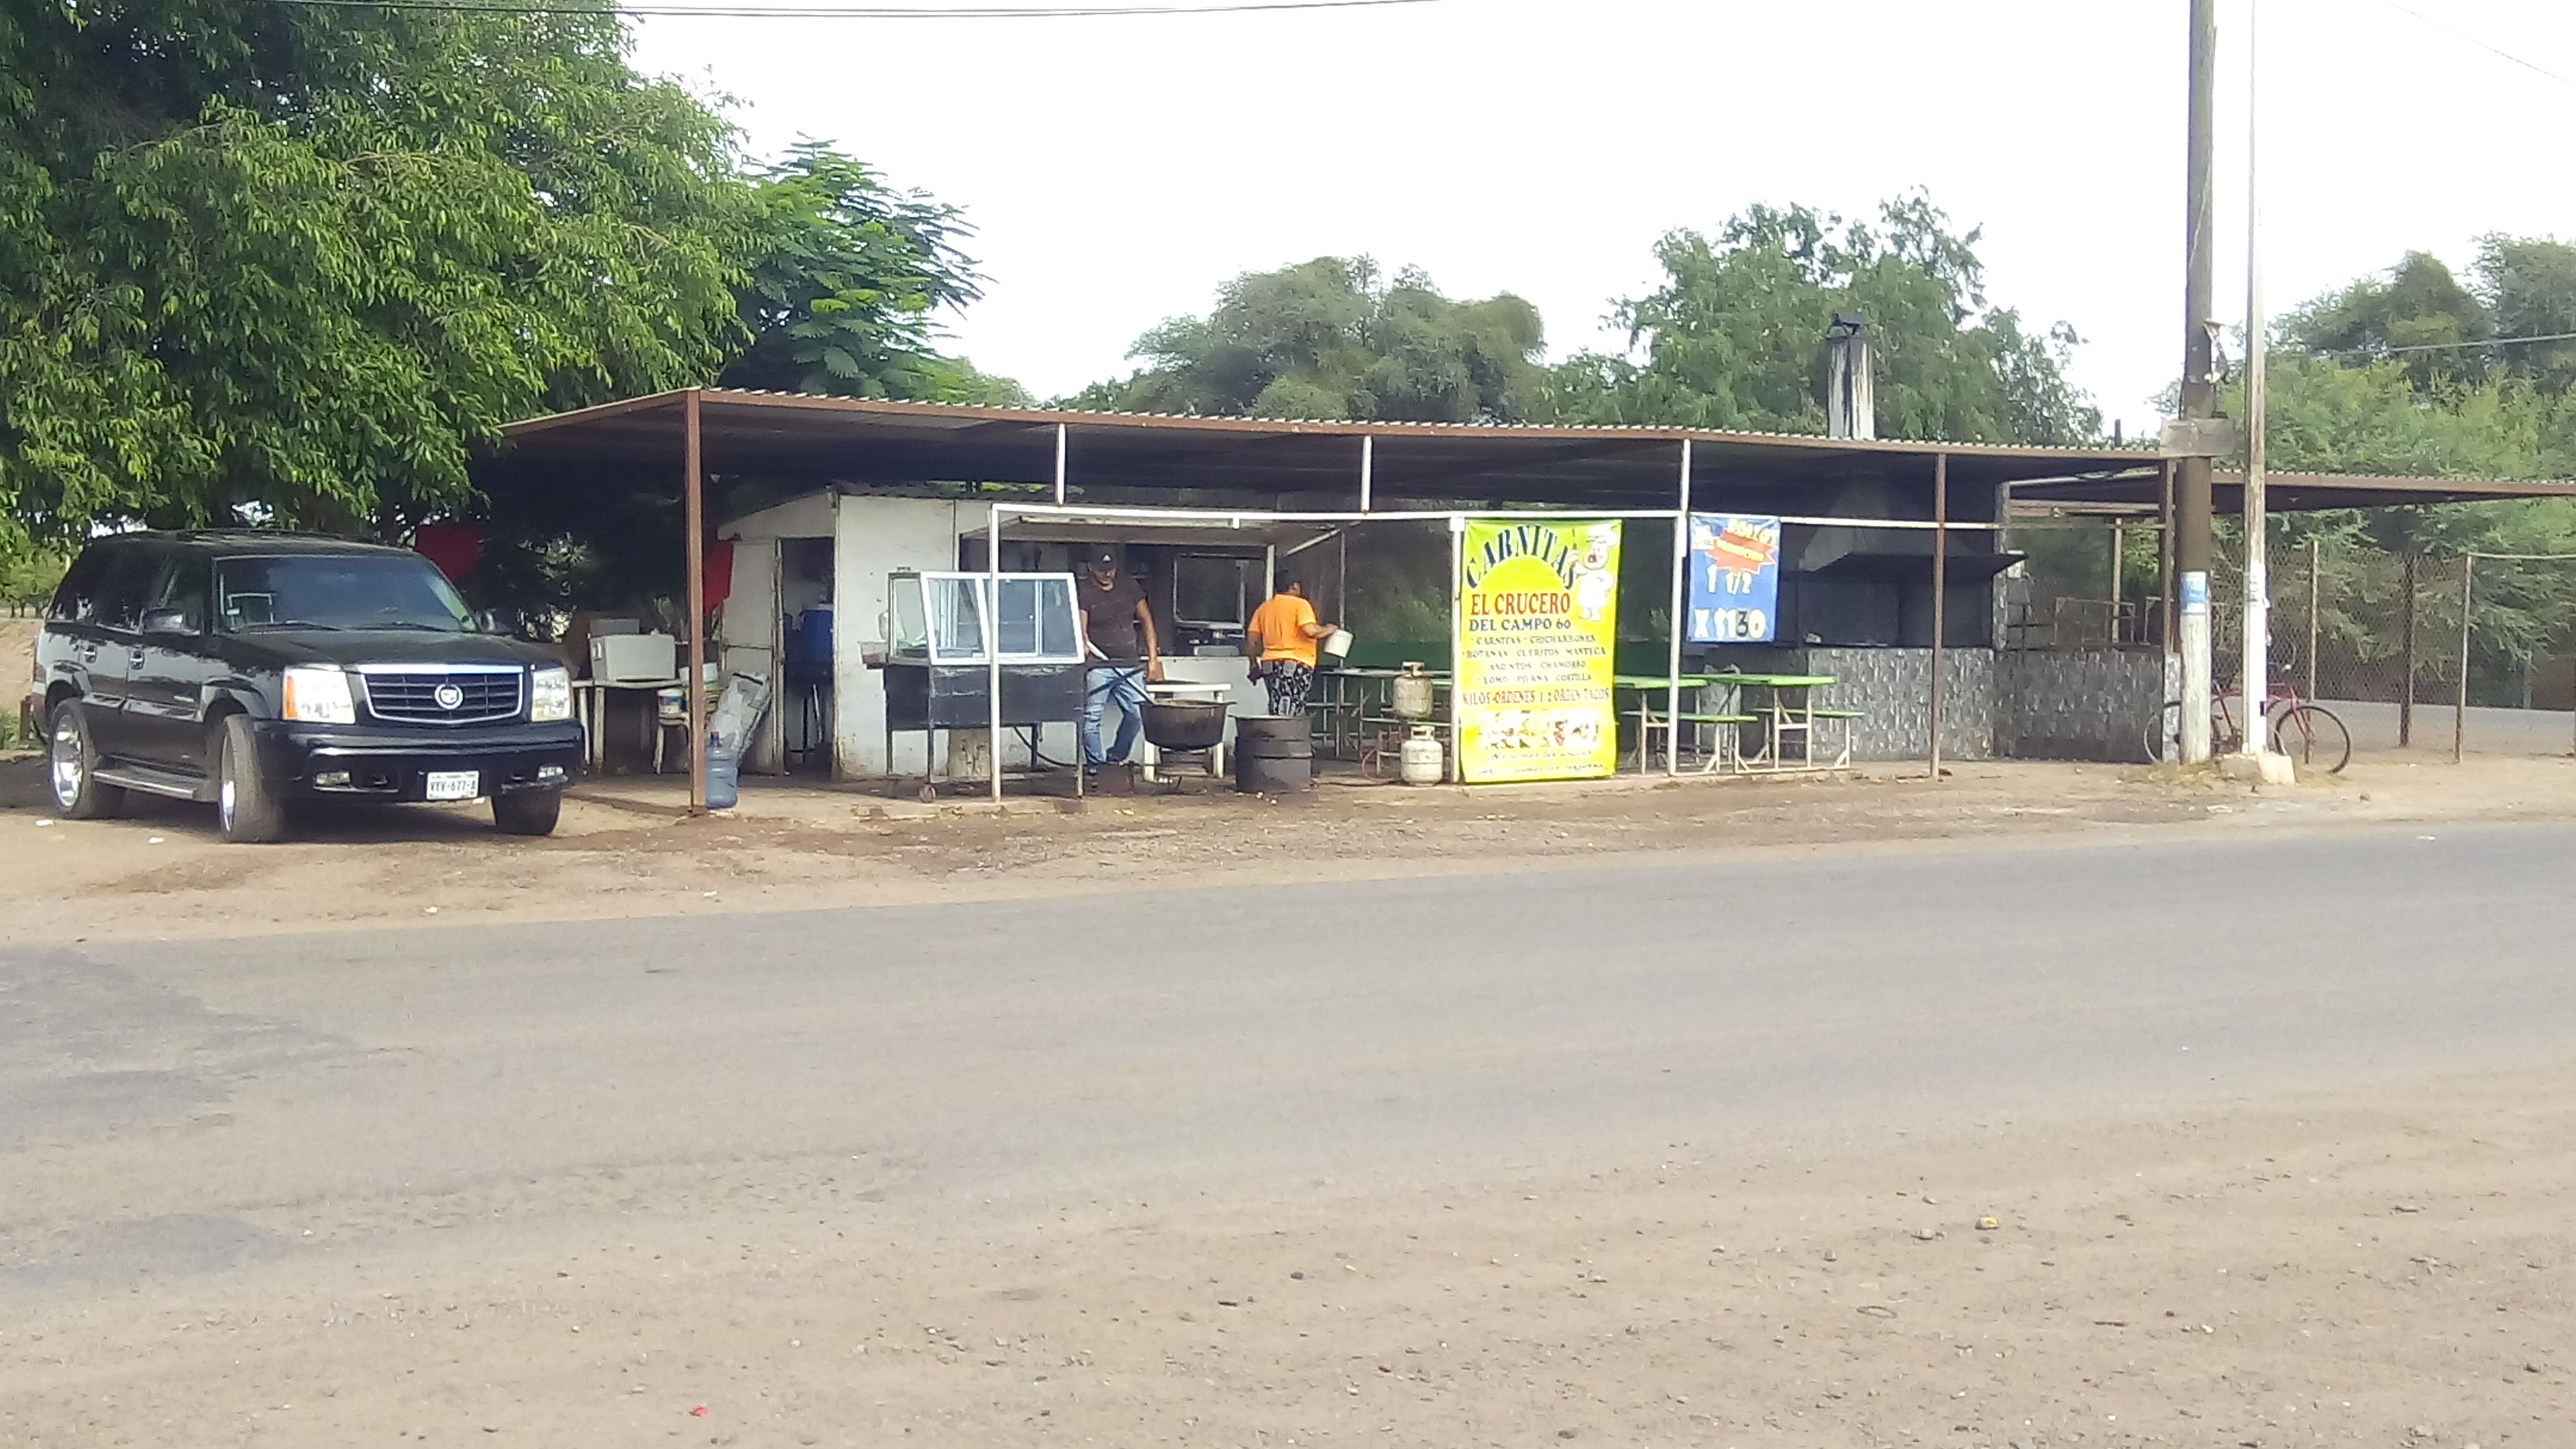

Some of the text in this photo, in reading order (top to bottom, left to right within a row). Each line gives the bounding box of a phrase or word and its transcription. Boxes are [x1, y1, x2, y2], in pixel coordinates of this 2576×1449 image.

[1466, 524, 1574, 590] CARNITAS
[1707, 564, 1752, 594] 1 1/2
[1470, 592, 1570, 615] EL CRUCERO
[1469, 618, 1571, 631] DEL CAMPO 60
[1714, 607, 1766, 639] $130
[1476, 636, 1521, 645] CARNITAS
